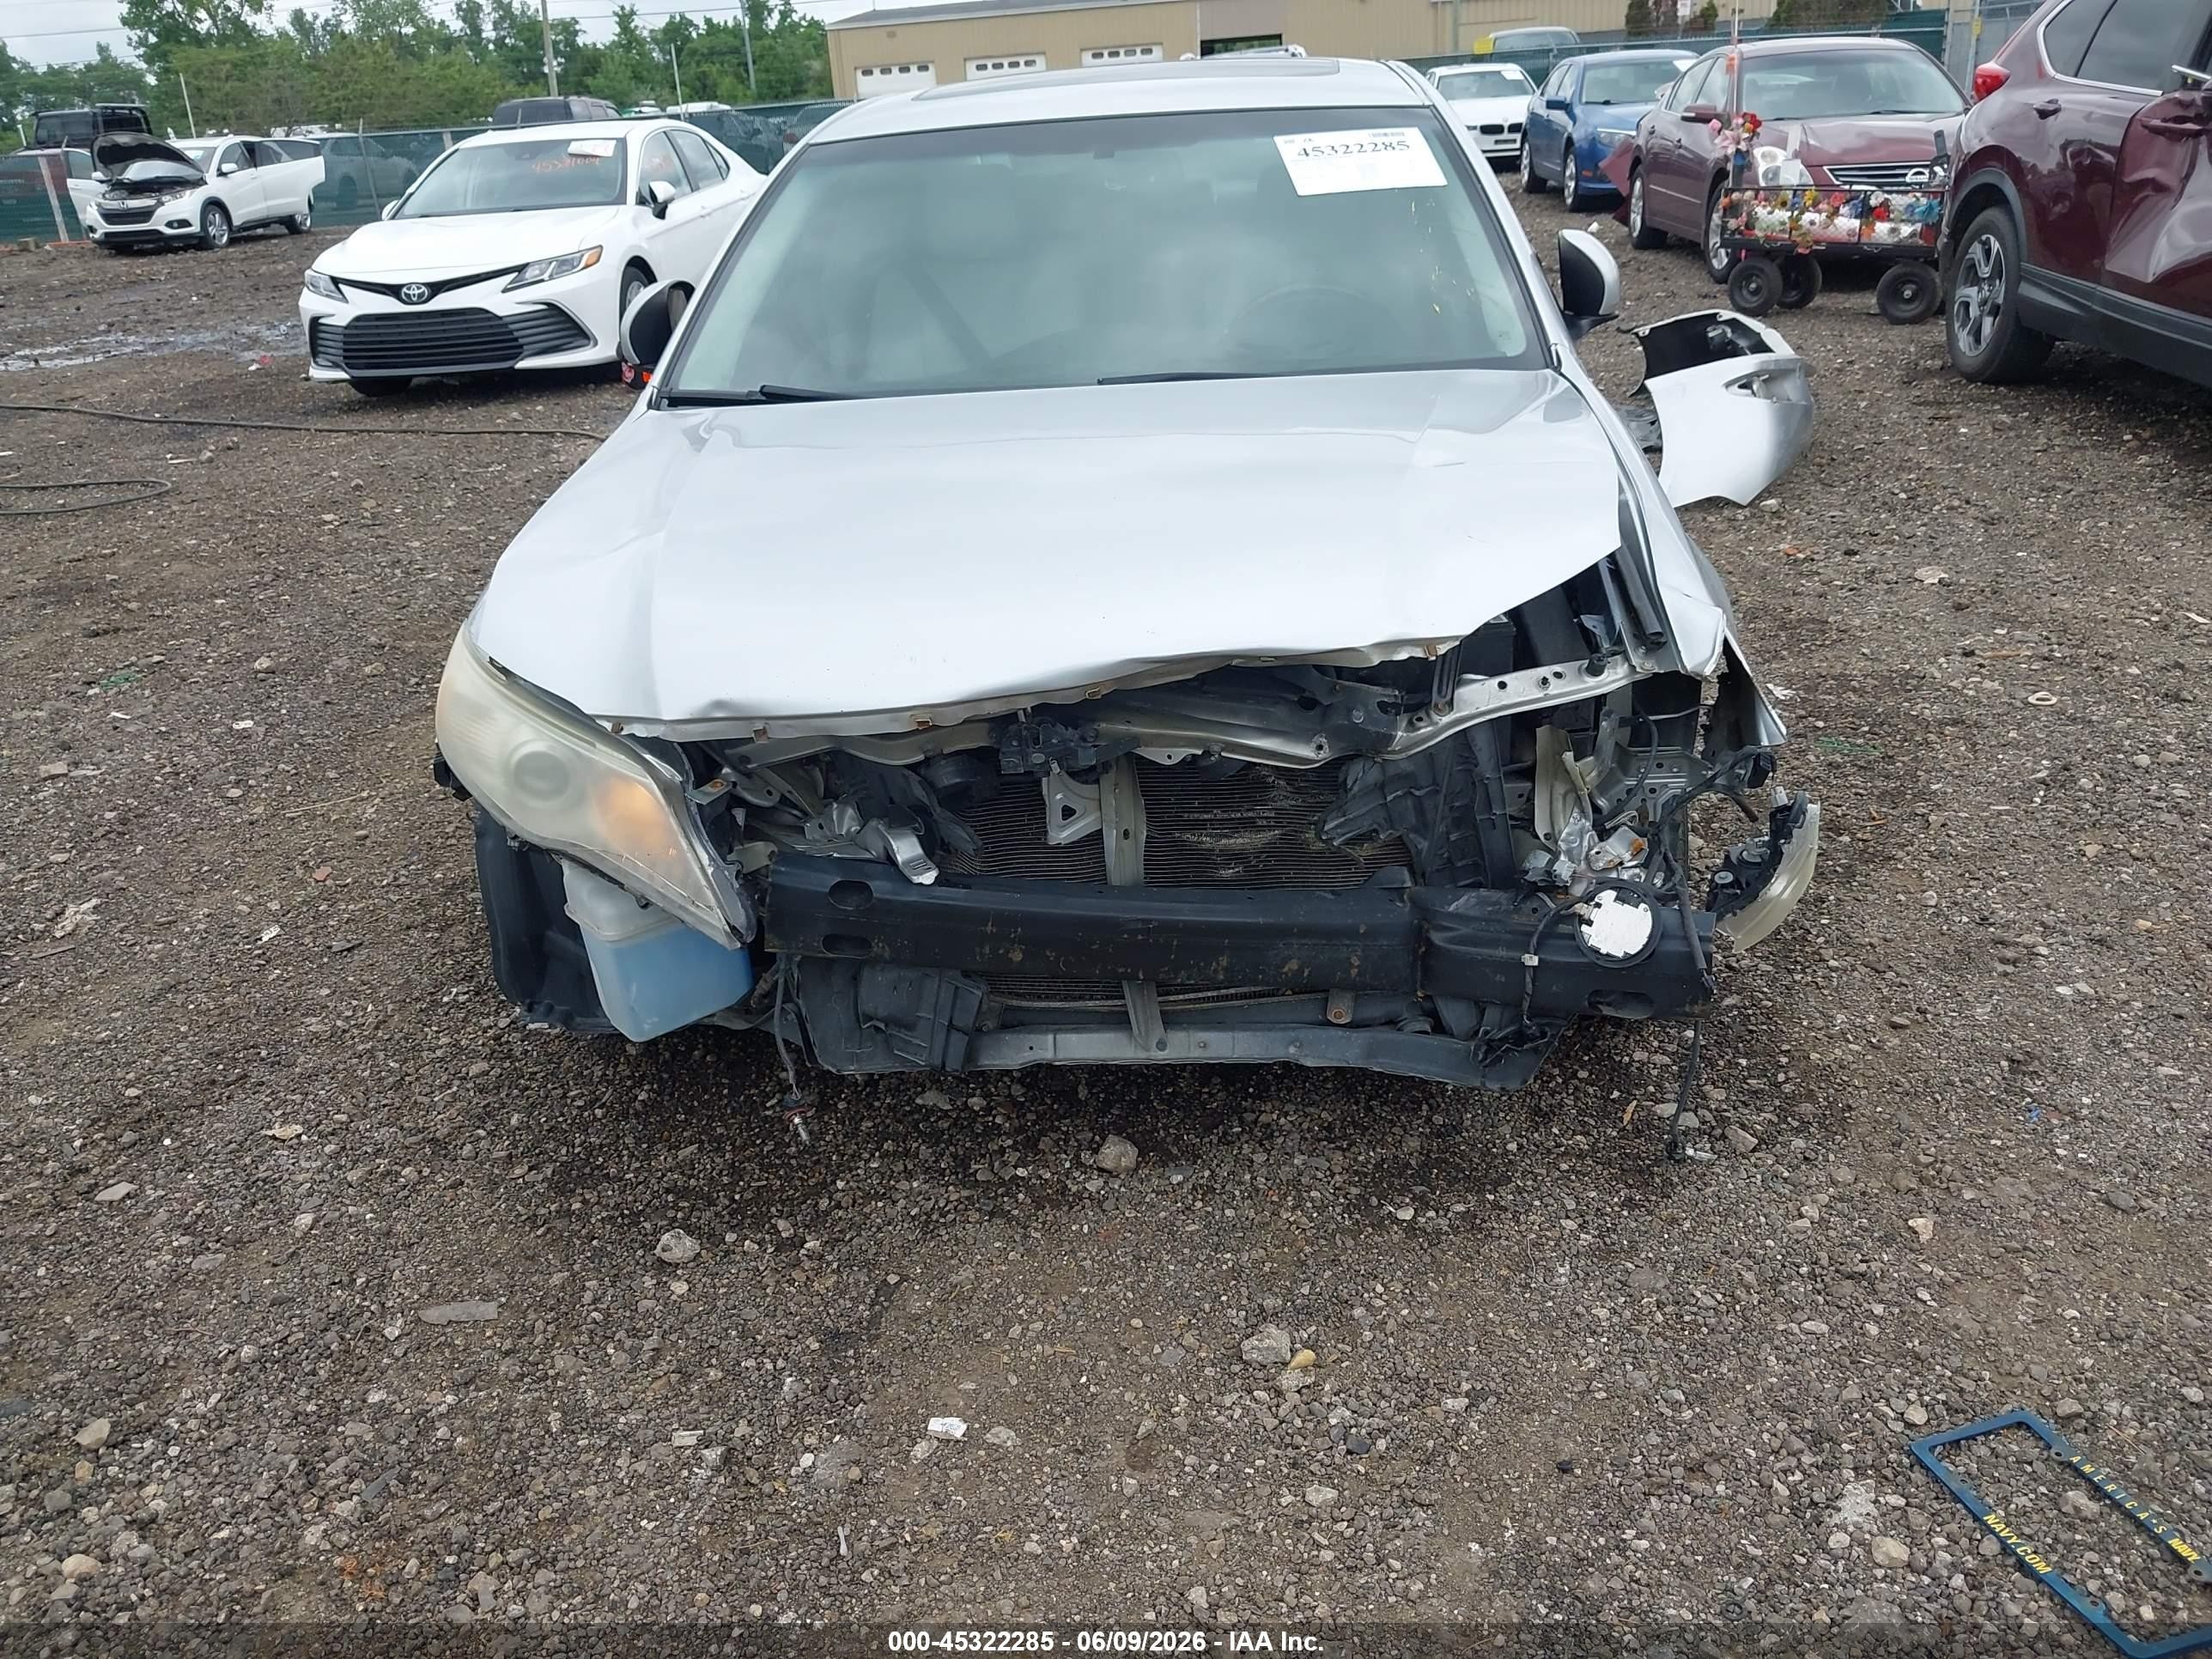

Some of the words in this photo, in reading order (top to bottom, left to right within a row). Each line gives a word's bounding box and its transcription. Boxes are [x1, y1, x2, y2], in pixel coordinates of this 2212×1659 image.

[1297, 140, 1411, 158] 45322285
[1983, 1514, 2052, 1574] NAVY.COM
[2168, 1538, 2201, 1564] NAVY
